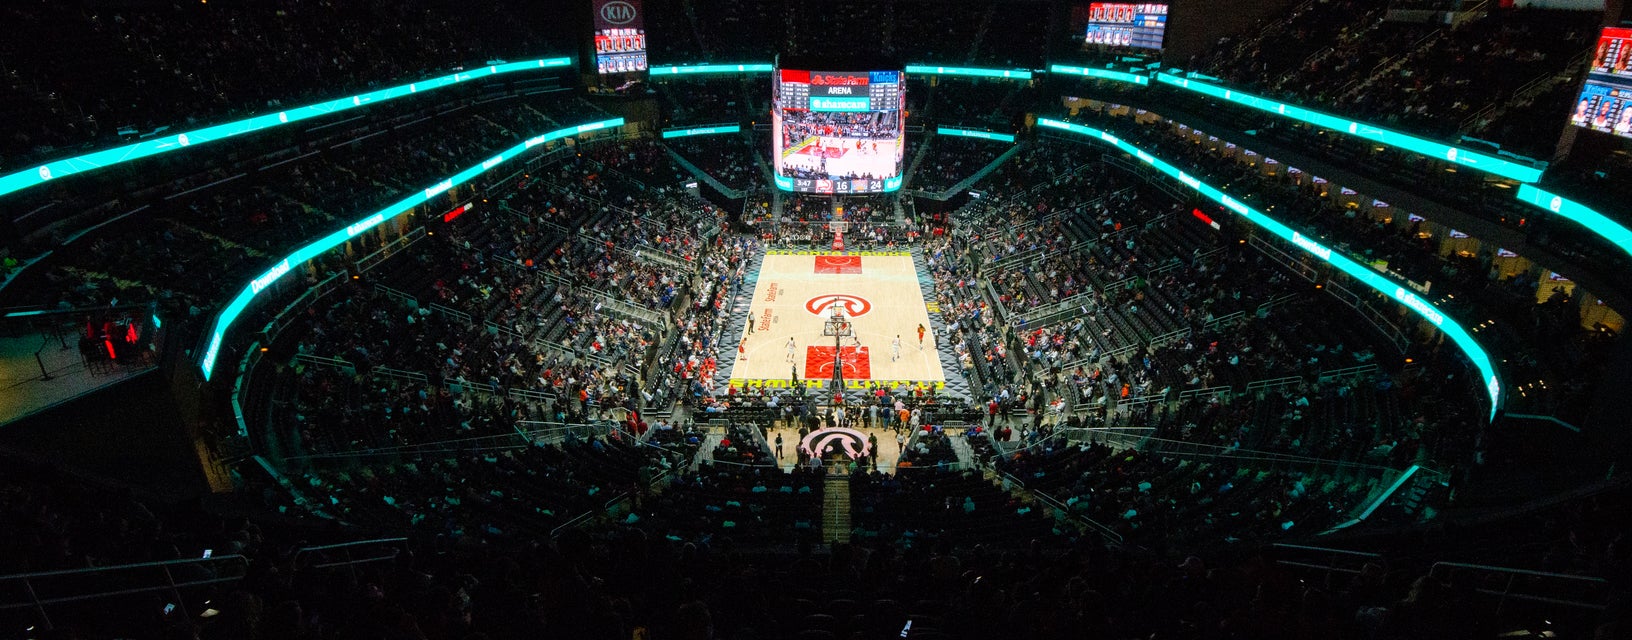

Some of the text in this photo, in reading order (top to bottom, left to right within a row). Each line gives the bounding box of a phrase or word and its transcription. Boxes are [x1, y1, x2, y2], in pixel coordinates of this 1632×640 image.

[606, 6, 631, 20] KIA
[873, 72, 897, 83] Knicks
[828, 86, 852, 95] ARENA
[821, 100, 867, 109] sharecare
[836, 181, 848, 190] 16
[870, 180, 882, 189] 24
[1292, 231, 1332, 261] Download
[251, 258, 290, 294] Download
[1404, 293, 1444, 326] sharecare
